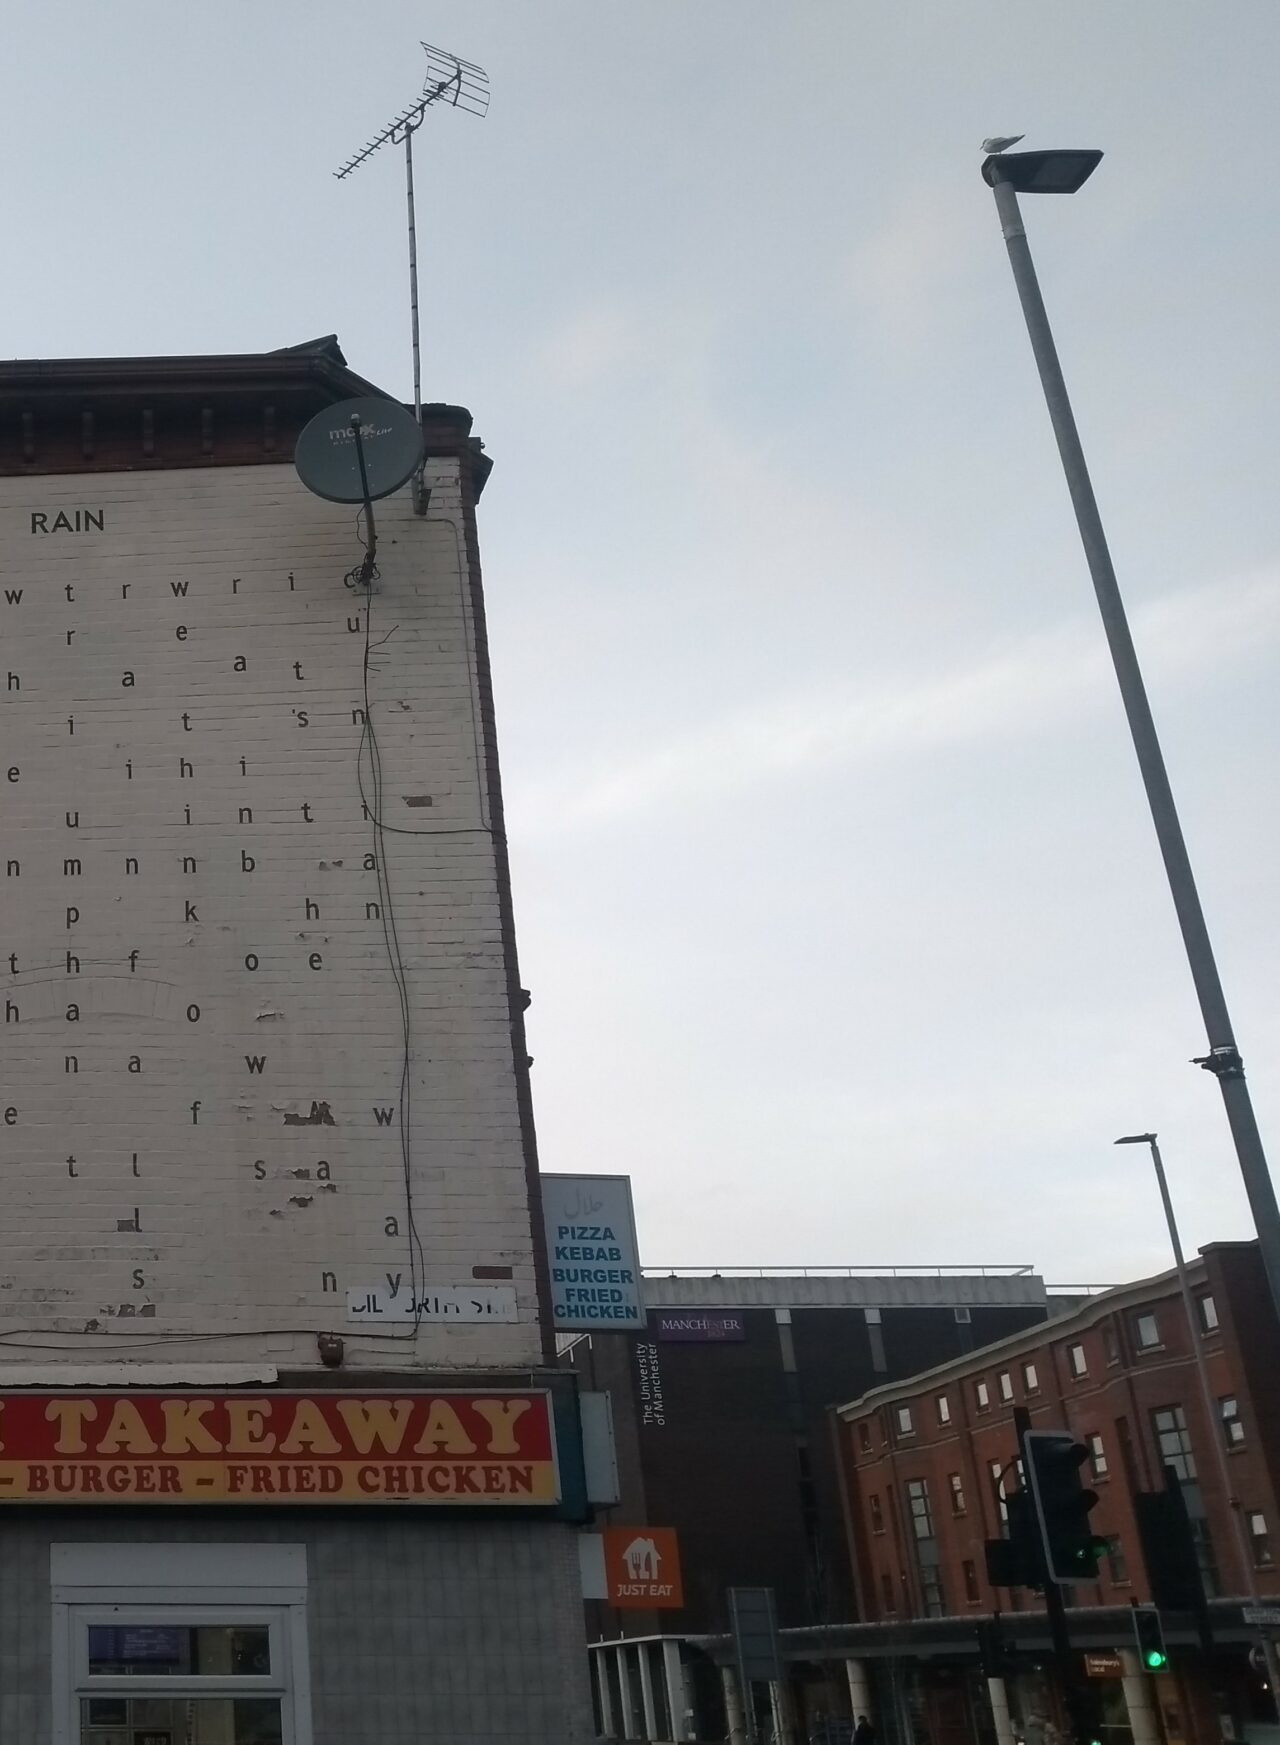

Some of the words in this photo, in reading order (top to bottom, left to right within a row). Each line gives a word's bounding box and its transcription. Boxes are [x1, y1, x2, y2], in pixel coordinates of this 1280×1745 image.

[31, 509, 105, 535] RAIN
[4, 589, 24, 604] w
[64, 583, 75, 602] t
[122, 583, 132, 599] r
[169, 581, 189, 597] w
[232, 578, 241, 594] r
[287, 571, 295, 591] i
[66, 630, 76, 645] r
[175, 625, 188, 641] e
[347, 616, 361, 633] u
[7, 671, 20, 690] h
[121, 671, 135, 687] a
[233, 655, 247, 671] a
[292, 661, 305, 680] t
[67, 715, 74, 735] i
[181, 712, 193, 731] t
[352, 707, 366, 726] n
[7, 766, 20, 782] e
[125, 759, 132, 779] i
[180, 757, 194, 777] h
[240, 755, 248, 776] i
[65, 811, 79, 827] u
[184, 804, 192, 825] i
[238, 807, 253, 824] n
[300, 802, 314, 823] t
[7, 860, 20, 876] n
[63, 858, 82, 875] m
[125, 857, 139, 874] n
[183, 856, 197, 873] n
[241, 849, 256, 872] b
[363, 852, 377, 871] a
[66, 906, 80, 929] p
[185, 900, 200, 921] k
[305, 897, 320, 920] h
[365, 902, 380, 920] n
[8, 952, 20, 974] t
[66, 950, 80, 973] h
[128, 949, 140, 972] f
[244, 953, 259, 971] o
[308, 952, 323, 970] e
[5, 999, 20, 1022] h
[65, 1003, 80, 1021] a
[186, 1004, 201, 1022] o
[65, 1055, 79, 1073] n
[127, 1055, 141, 1073] a
[244, 1055, 267, 1074] w
[4, 1106, 18, 1125] e
[189, 1100, 202, 1124] f
[372, 1107, 395, 1126] w
[66, 1155, 79, 1177] t
[253, 1159, 267, 1180] s
[316, 1160, 331, 1180] a
[564, 1188, 604, 1220] حلال
[384, 1216, 399, 1236] a
[558, 1226, 615, 1241] PIZZA
[554, 1246, 621, 1261] KEBAB
[132, 1268, 145, 1289] s
[322, 1271, 337, 1292] n
[385, 1273, 402, 1298] y
[552, 1268, 634, 1284] BURGER
[565, 1288, 623, 1302] FRIED
[554, 1304, 638, 1319] CHICKEN
[637, 1343, 651, 1400] University
[649, 1343, 664, 1411] Manchester
[44, 1399, 532, 1454] TAKEAWAY
[643, 1407, 654, 1425] The
[657, 1415, 665, 1426] of
[26, 1465, 182, 1493] BURGER
[227, 1465, 344, 1493] FRIED
[357, 1465, 534, 1494] CHICKEN
[617, 1584, 646, 1597] JUST
[649, 1585, 673, 1597] EAT
